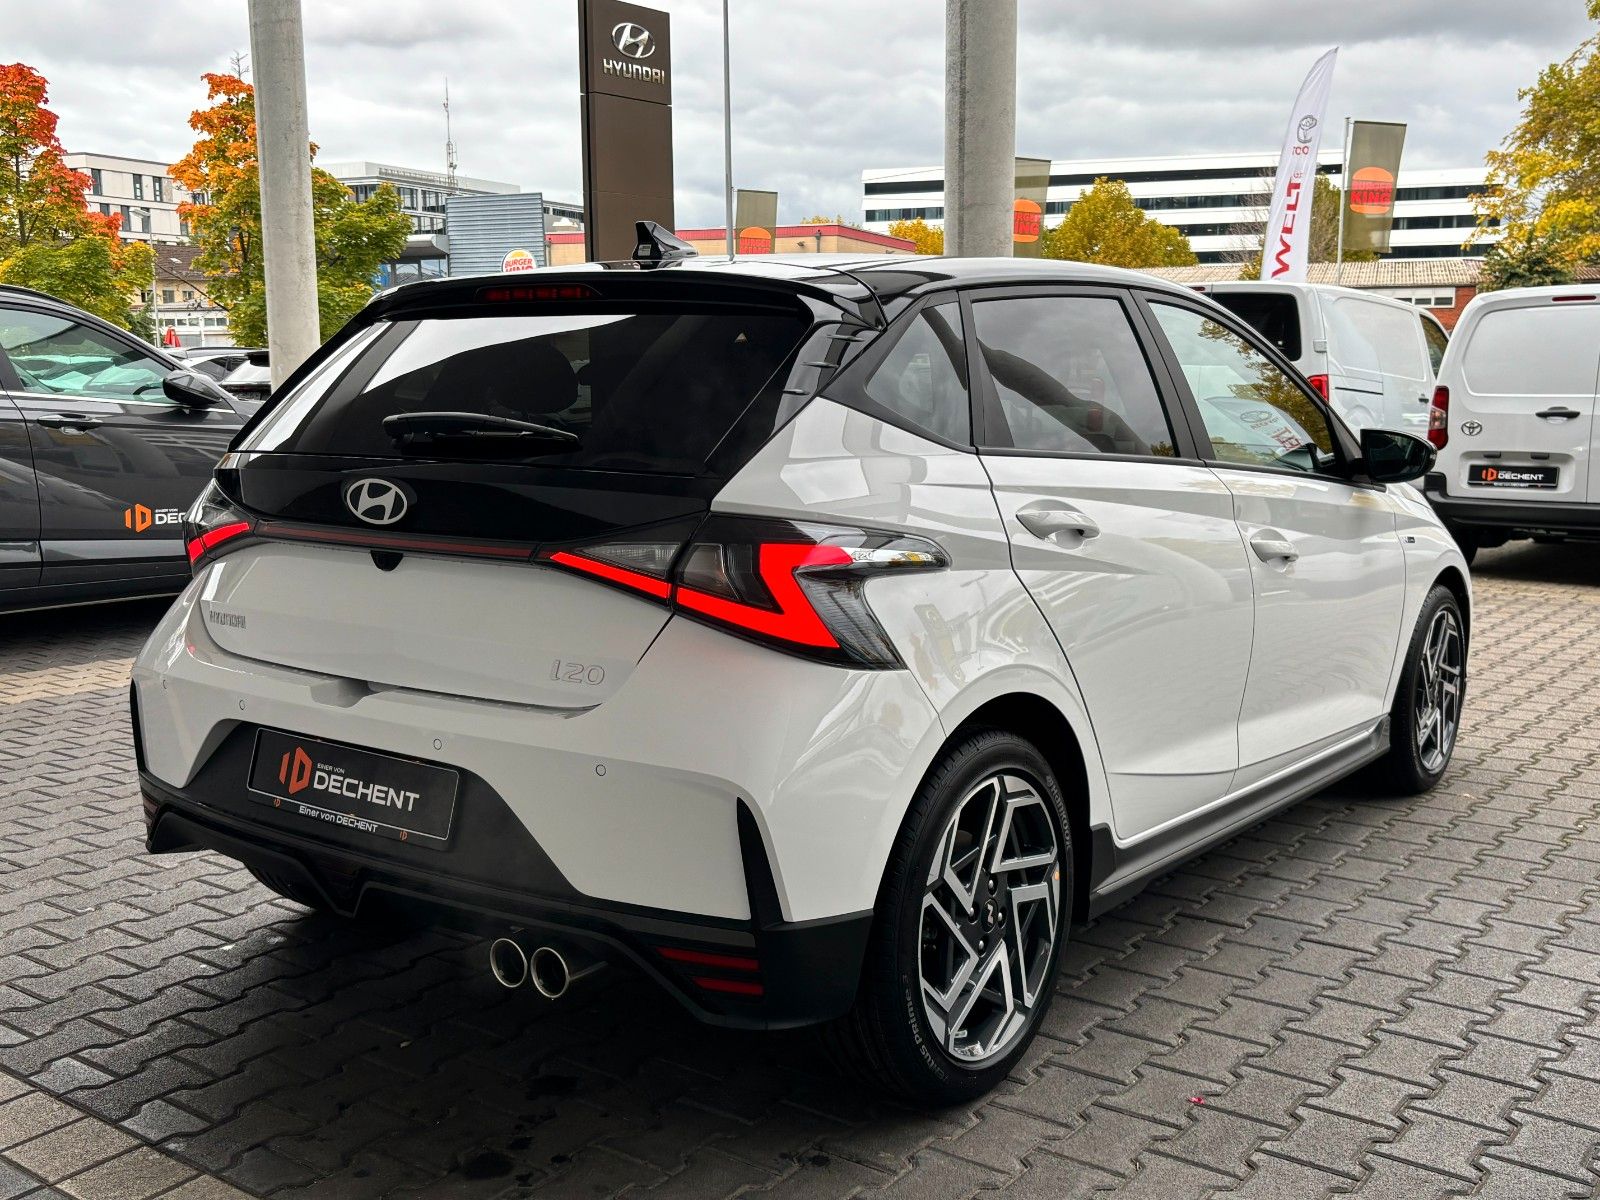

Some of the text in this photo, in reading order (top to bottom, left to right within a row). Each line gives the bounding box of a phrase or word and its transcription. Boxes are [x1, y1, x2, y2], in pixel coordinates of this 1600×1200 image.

[603, 58, 665, 85] HYUNDAI
[1350, 189, 1391, 205] KING
[1014, 221, 1040, 236] ING
[504, 258, 533, 269] BURGER
[1498, 471, 1544, 481] DECHENT
[317, 762, 333, 771] EINER
[313, 771, 420, 812] DECHENT
[299, 805, 378, 833] Einer von DECHENT
